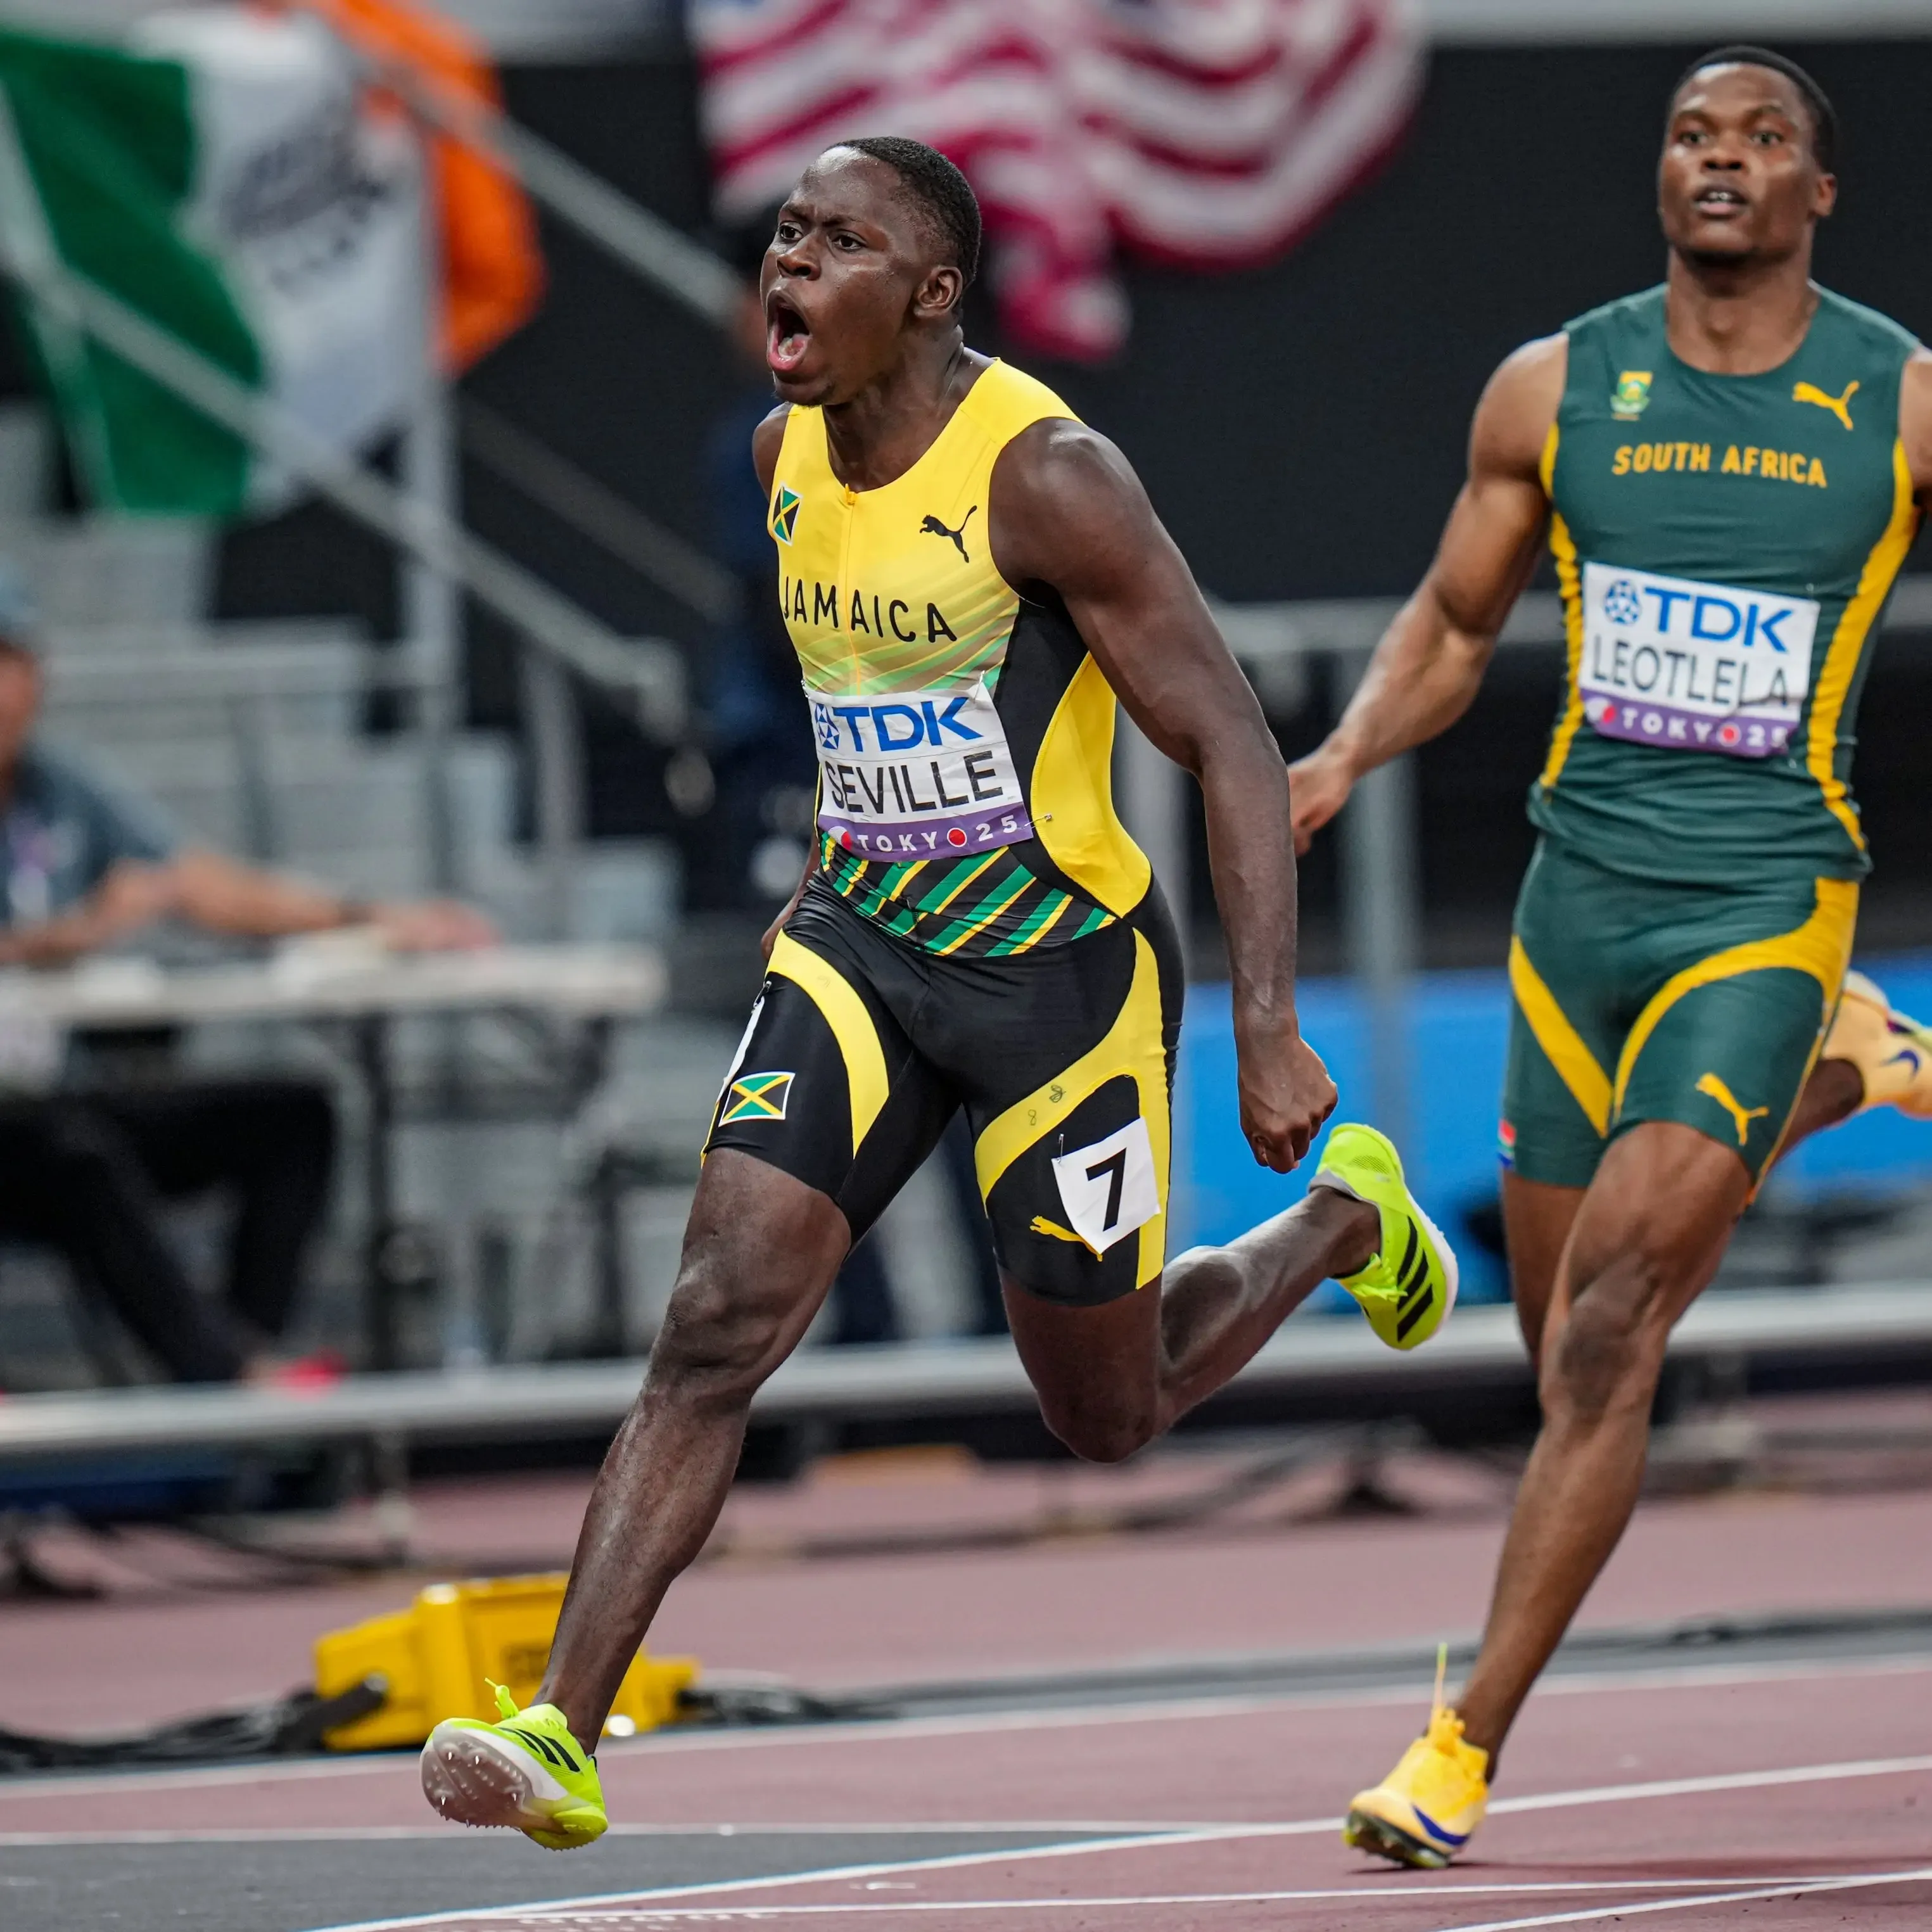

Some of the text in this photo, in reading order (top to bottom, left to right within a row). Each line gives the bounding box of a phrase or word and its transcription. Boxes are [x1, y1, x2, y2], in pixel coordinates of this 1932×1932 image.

[1611, 441, 1827, 488] SOUTH AFRICA
[783, 576, 958, 643] JAMAICA
[1644, 587, 1793, 653] TDK
[1592, 634, 1789, 707] LEOTLELA
[832, 697, 983, 752] TDK
[825, 750, 1003, 814] SEVILLE
[1085, 1147, 1127, 1231] 7
